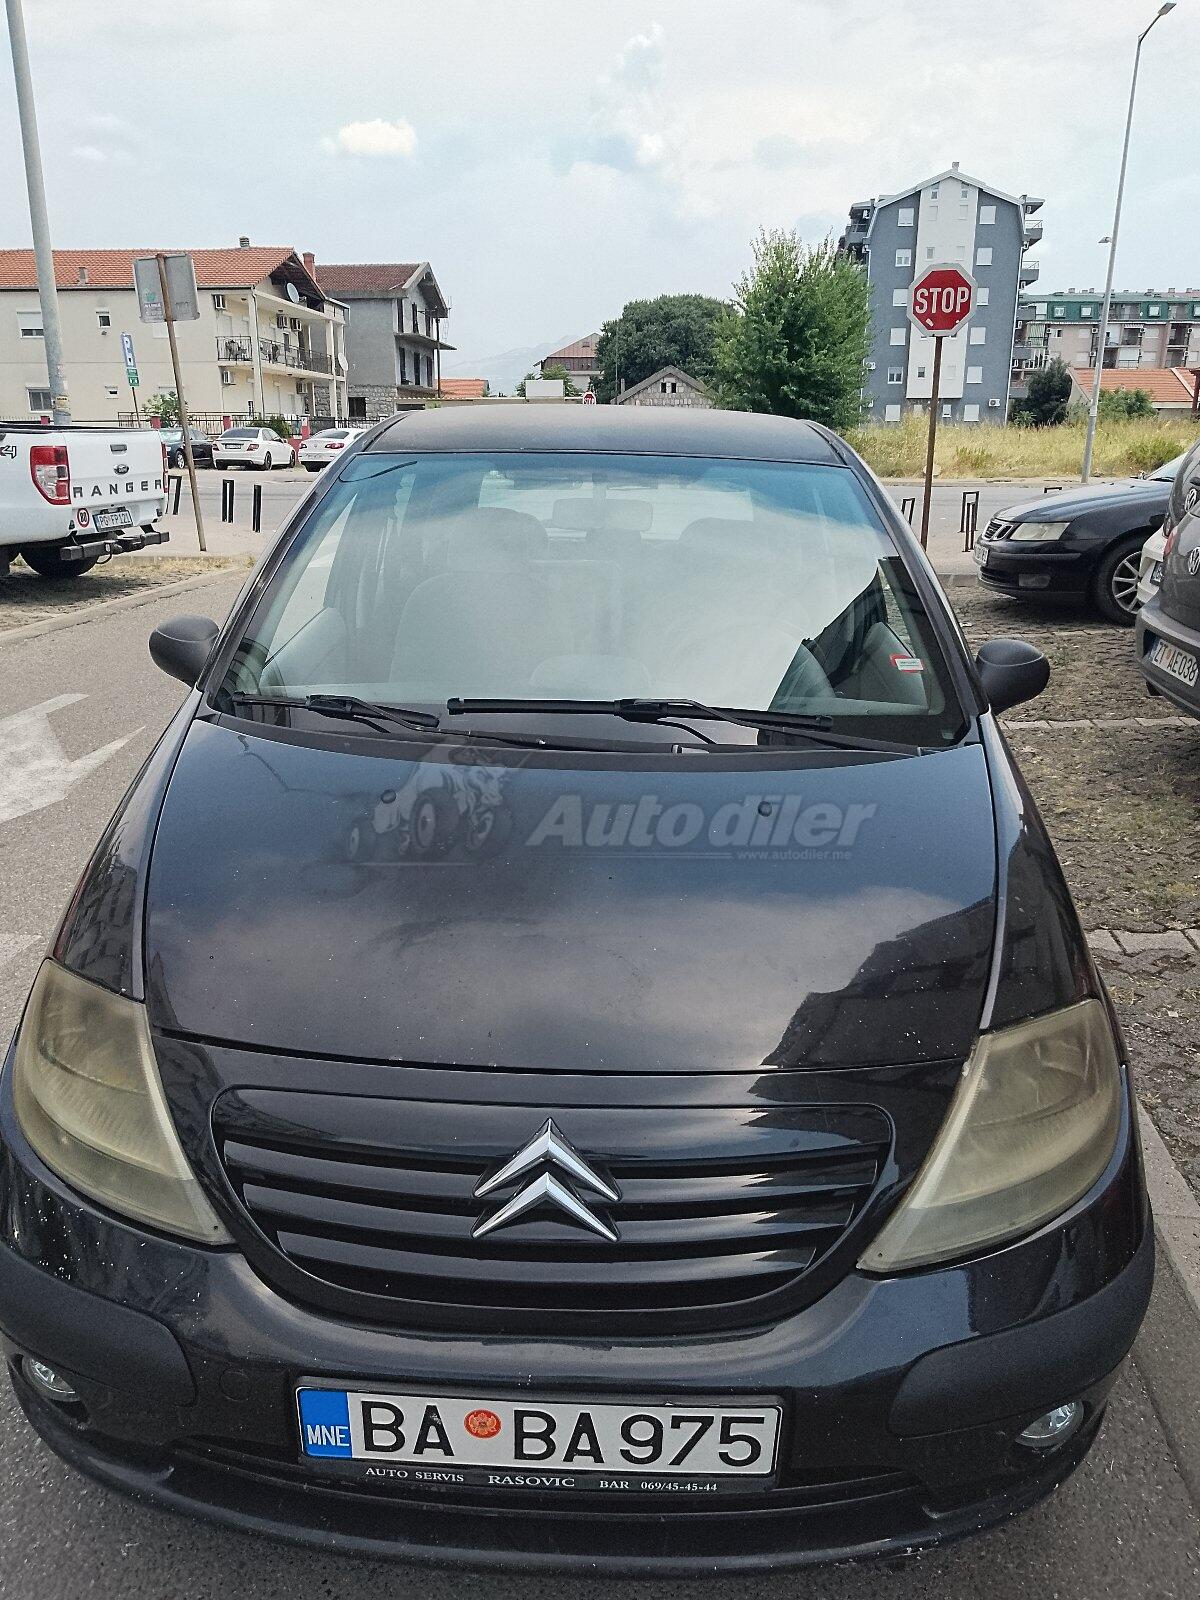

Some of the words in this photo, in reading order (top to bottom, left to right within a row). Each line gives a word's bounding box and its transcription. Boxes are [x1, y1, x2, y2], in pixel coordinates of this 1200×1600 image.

[915, 286, 969, 314] STOP
[73, 479, 162, 498] RANGER
[1154, 641, 1168, 663] ZT
[1167, 649, 1198, 681] AE038
[307, 1424, 350, 1447] MNE
[361, 1400, 455, 1457] BA
[365, 1467, 409, 1478] AUTO
[415, 1471, 464, 1482] SERVIS
[599, 1480, 629, 1489] BAR
[640, 1481, 718, 1491] 069/45-45-44
